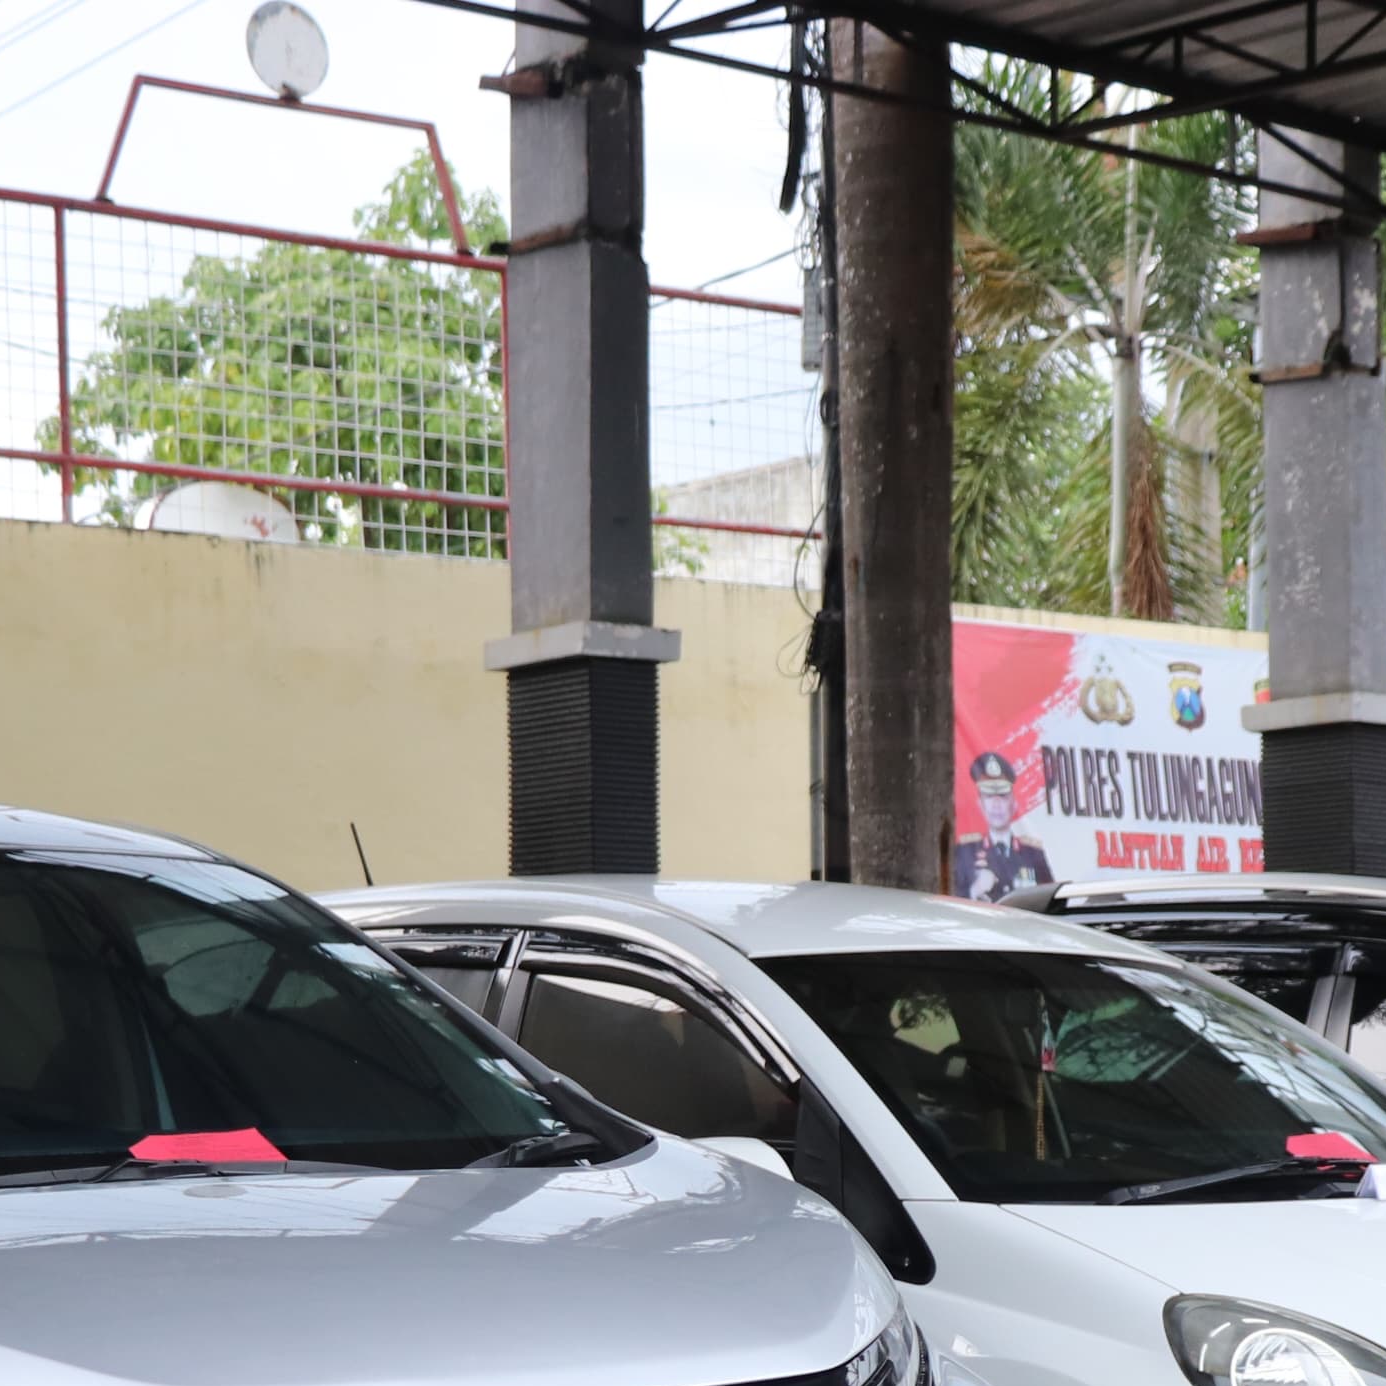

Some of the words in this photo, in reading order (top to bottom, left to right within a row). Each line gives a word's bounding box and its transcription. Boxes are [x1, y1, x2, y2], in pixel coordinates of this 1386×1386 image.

[1043, 746, 1123, 817] POLRES
[1096, 830, 1184, 870] BANTUAN
[1197, 834, 1229, 872] AIR
